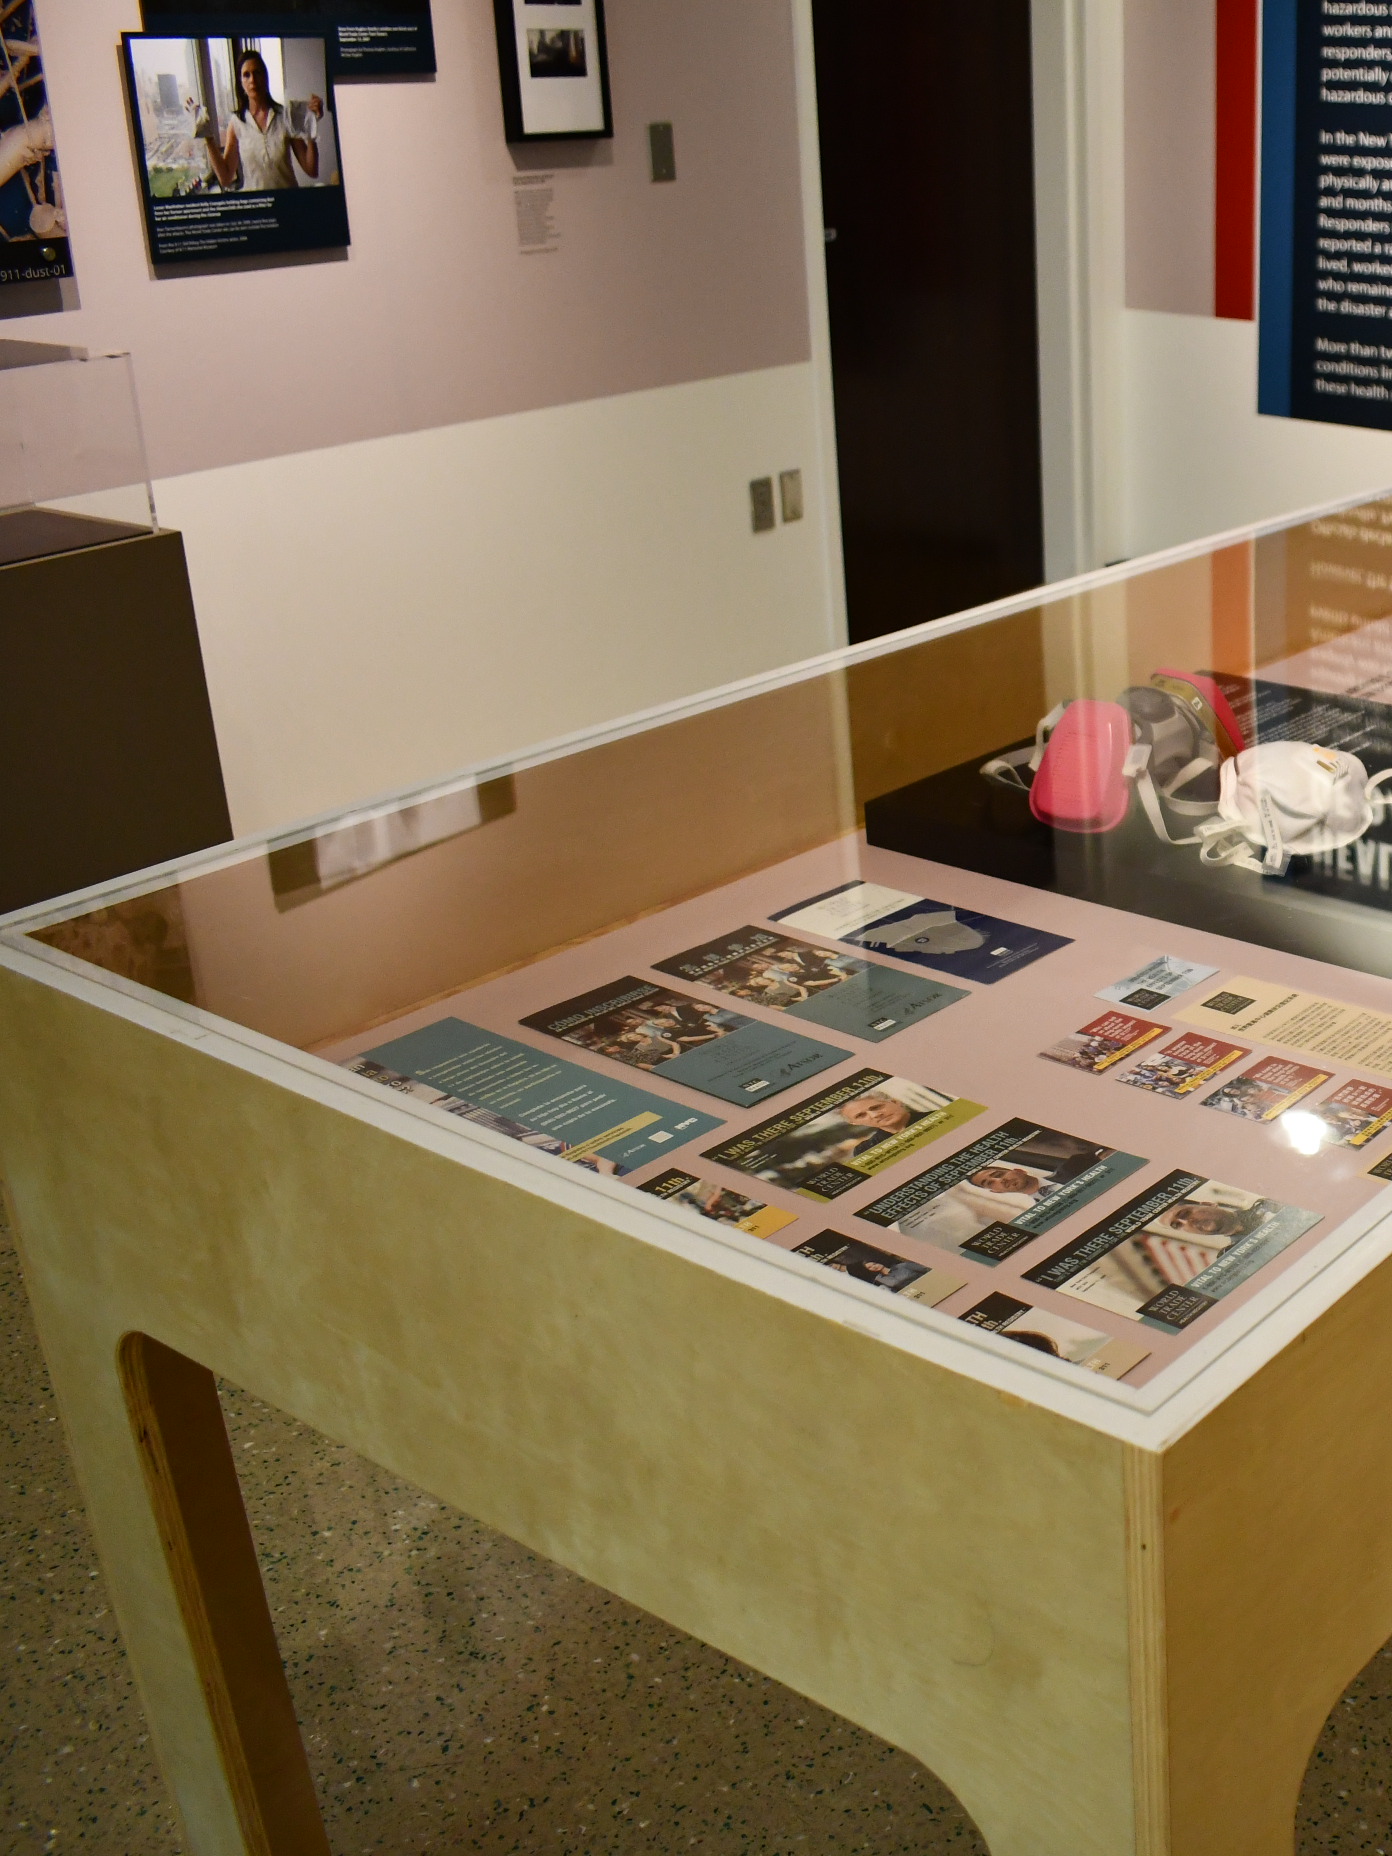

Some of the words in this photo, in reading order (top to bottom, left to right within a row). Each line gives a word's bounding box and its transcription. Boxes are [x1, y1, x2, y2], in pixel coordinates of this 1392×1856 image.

[1321, 0, 1388, 17] hazardous
[1321, 22, 1372, 39] workers
[1319, 129, 1333, 146] In
[1334, 130, 1356, 147] the
[1357, 131, 1387, 149] New
[1316, 336, 1348, 354] More
[1350, 341, 1377, 357] than
[1314, 361, 1378, 380] conditions
[1314, 377, 1348, 394] these
[1350, 381, 1388, 399] health
[722, 1139, 756, 1155] WAS
[751, 1119, 793, 1140] THERE
[786, 1086, 858, 1121] SEPTEMBER
[849, 1153, 874, 1165] VITAL
[880, 1139, 900, 1149] NEW
[919, 1111, 949, 1126] HEALTH
[948, 1151, 975, 1165] THE
[968, 1130, 1010, 1154] HEALTH
[804, 1167, 841, 1184] WORLD
[814, 1171, 845, 1186] TRADE
[817, 1172, 857, 1192] CENTER
[880, 1190, 930, 1219] EFFECTS
[923, 1181, 944, 1192] OF
[937, 1148, 999, 1184] SEPTEMBER
[1013, 1211, 1038, 1225] VITAL
[1032, 1204, 1047, 1212] TO
[1041, 1195, 1062, 1206] NEW
[1080, 1164, 1108, 1180] HEALTH
[969, 1226, 1005, 1246] WORLD
[980, 1231, 1010, 1248] TRADE
[984, 1232, 1023, 1254] CENTER
[1046, 1256, 1080, 1276] WAS
[1072, 1232, 1115, 1258] THERE
[1107, 1192, 1172, 1233] SEPTEMBER
[1188, 1273, 1214, 1288] VITAL
[1207, 1266, 1223, 1274] TO
[1216, 1255, 1238, 1267] NEW
[1252, 1221, 1282, 1239] HEALTH
[1145, 1289, 1182, 1312] WORLD
[1157, 1294, 1189, 1314] TRADE
[1162, 1295, 1202, 1320] CENTER
